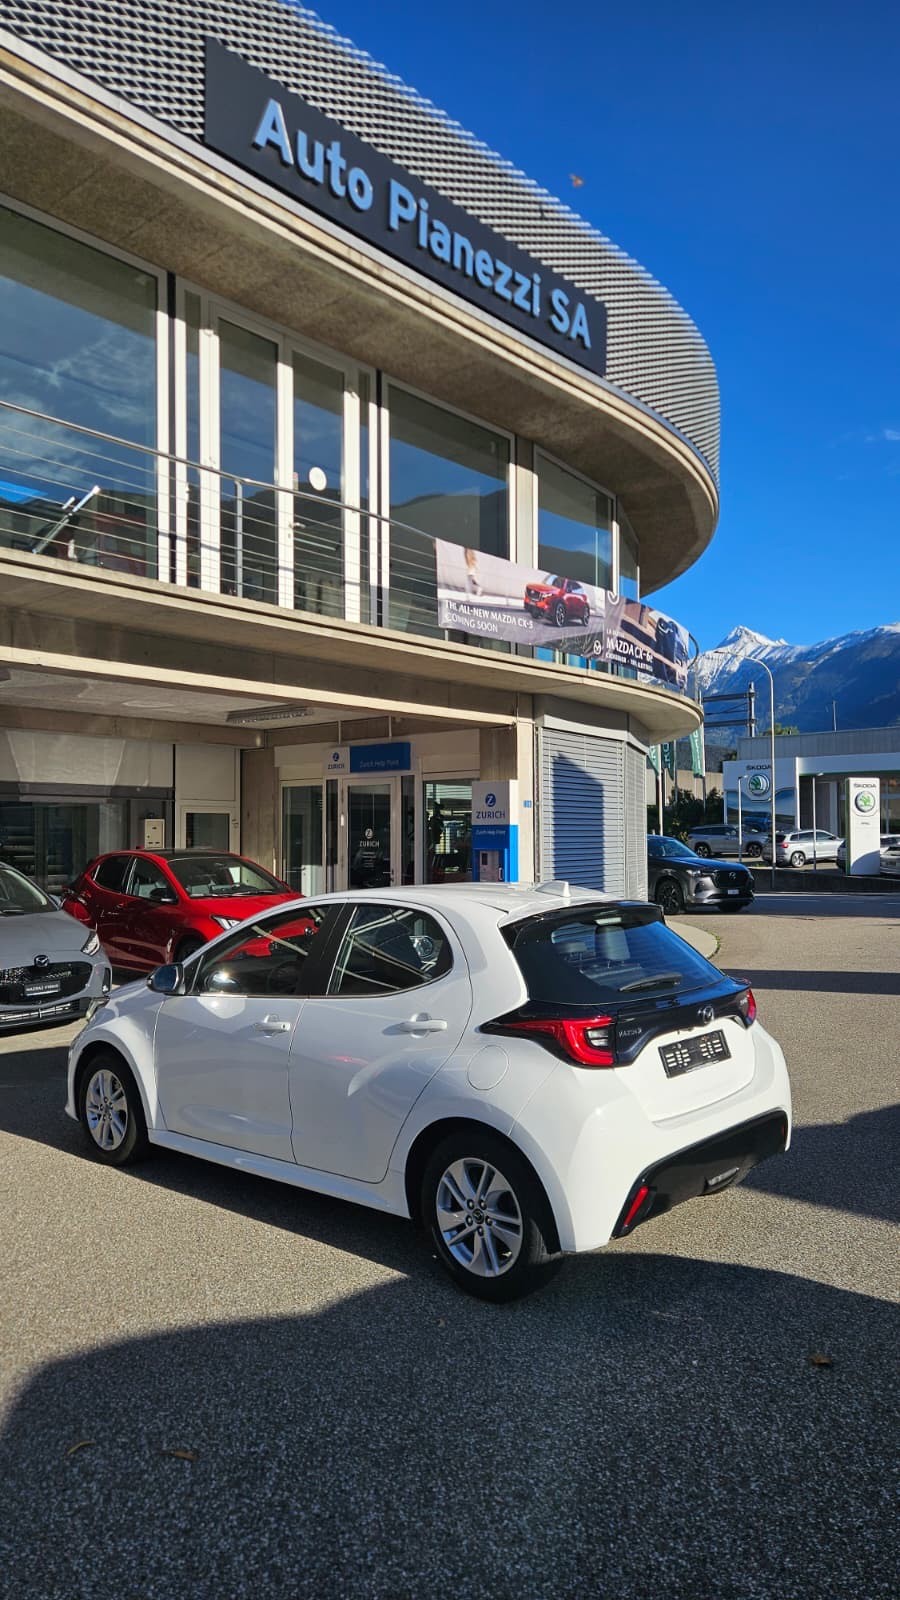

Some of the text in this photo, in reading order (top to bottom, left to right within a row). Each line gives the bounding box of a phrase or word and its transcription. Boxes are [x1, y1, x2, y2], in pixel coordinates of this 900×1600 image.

[252, 98, 592, 350] Auto Pianezzi SA
[458, 603, 490, 619] ALL-NEW
[491, 611, 517, 625] MAZDA
[477, 620, 498, 633] SOON
[606, 637, 634, 657] MAZDA
[476, 810, 506, 820] ZURICH
[359, 840, 380, 848] ZURICH
